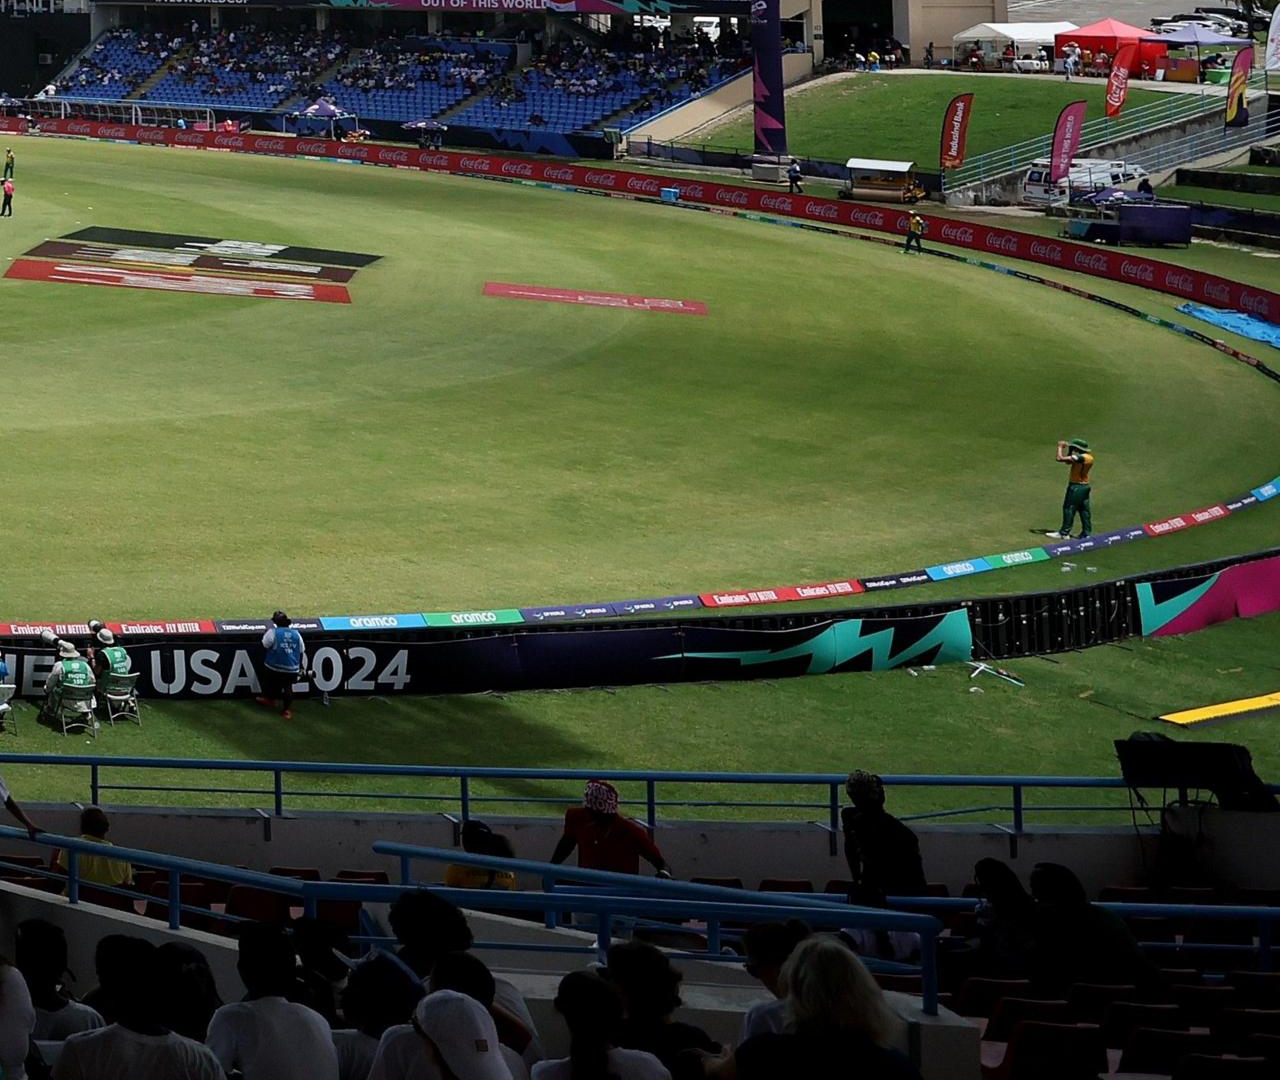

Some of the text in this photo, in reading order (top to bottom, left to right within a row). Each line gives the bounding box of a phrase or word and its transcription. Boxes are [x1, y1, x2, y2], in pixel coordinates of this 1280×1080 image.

[350, 616, 398, 628] aramco
[450, 612, 496, 624] aramco
[10, 624, 54, 635] Emirates
[56, 624, 67, 634] FLY
[122, 622, 200, 634] Emirates FLY BETTER
[151, 649, 263, 696] USA
